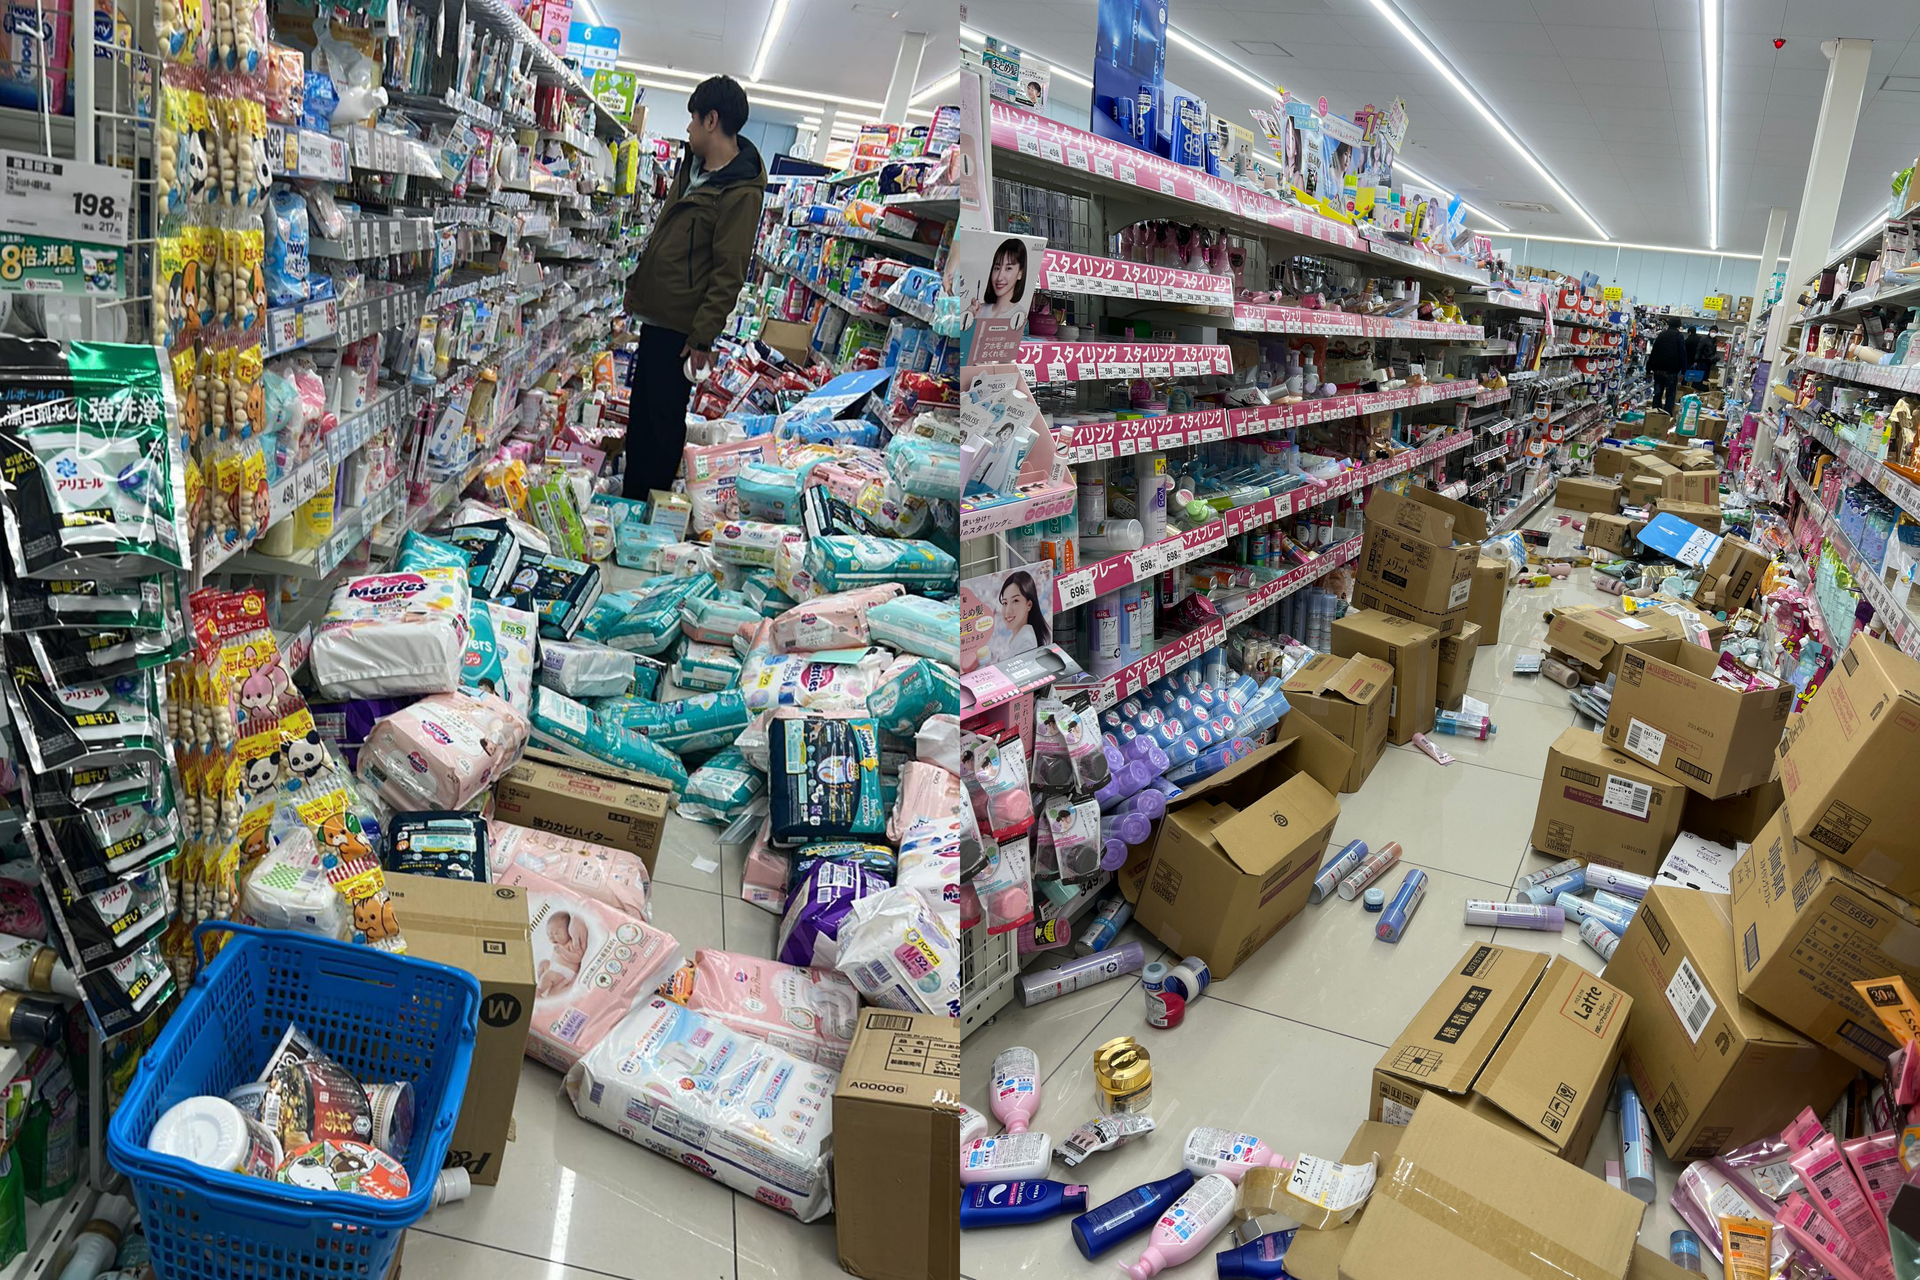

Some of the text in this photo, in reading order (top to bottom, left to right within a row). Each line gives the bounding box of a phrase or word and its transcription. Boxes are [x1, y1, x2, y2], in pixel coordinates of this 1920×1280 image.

[584, 28, 591, 40] 6
[992, 58, 1018, 76] まとめ髪
[1136, 117, 1145, 135] 8
[1048, 122, 1118, 160] スタイリング
[1124, 148, 1181, 180] スタイリング
[1186, 169, 1232, 197] スタイリング
[1241, 189, 1257, 205] Pick
[73, 192, 123, 221] 198円
[1046, 253, 1227, 291] スタイリング スタイリング スタイリング
[1243, 306, 1356, 325] マシェリ マシェリ マシェリ マシェリ
[1018, 345, 1226, 363] ング スタイリング スタイリング スタイリング
[1025, 369, 1035, 378] 598
[1057, 368, 1066, 377] 598
[960, 411, 980, 425] BIOLISS
[1007, 404, 1025, 418] BIOLISS
[1241, 399, 1349, 422] リーゼ リーゼ リーゼ リーゼ
[1074, 409, 1222, 445] イリング スタイリング スタイリング
[56, 478, 104, 490] アリエール
[1238, 475, 1343, 523] リーゼ リーゼ リーゼ
[962, 514, 991, 527] 使い分けで
[1051, 517, 1059, 532] O5
[1381, 528, 1388, 538] 15
[1092, 563, 1118, 581] プレー
[1183, 525, 1220, 546] ヘアスプレー
[1166, 550, 1181, 563] 698円
[1140, 559, 1156, 573] 698円
[1294, 549, 1344, 578] ヘアフォーム ヘアフォーム
[1384, 558, 1410, 576] メリット
[1455, 570, 1472, 582] メリット
[348, 579, 428, 598] Merries
[1070, 585, 1090, 600] 698円
[218, 620, 265, 635] たまごボーロ
[1102, 619, 1116, 630] ケープ
[1126, 623, 1220, 678] ヘアスプレー ヘアスプレー
[62, 689, 104, 701] アリエール
[1104, 690, 1115, 701] 398
[421, 719, 454, 745] Merries
[407, 753, 429, 774] Merries
[533, 817, 614, 842] 強力カビハイター
[1700, 845, 1722, 858] ケープ
[1769, 836, 1787, 902] Styling Spray
[1760, 858, 1772, 909] スタイリングスプレー
[1849, 906, 1875, 926] 5654
[903, 946, 917, 961] M
[920, 941, 935, 957] パンツ
[1466, 949, 1488, 974] 0078793
[1574, 985, 1602, 1021] Latte
[1441, 989, 1486, 1039] 横積厳禁
[849, 1081, 905, 1094] A00006
[681, 1153, 717, 1177] Merries
